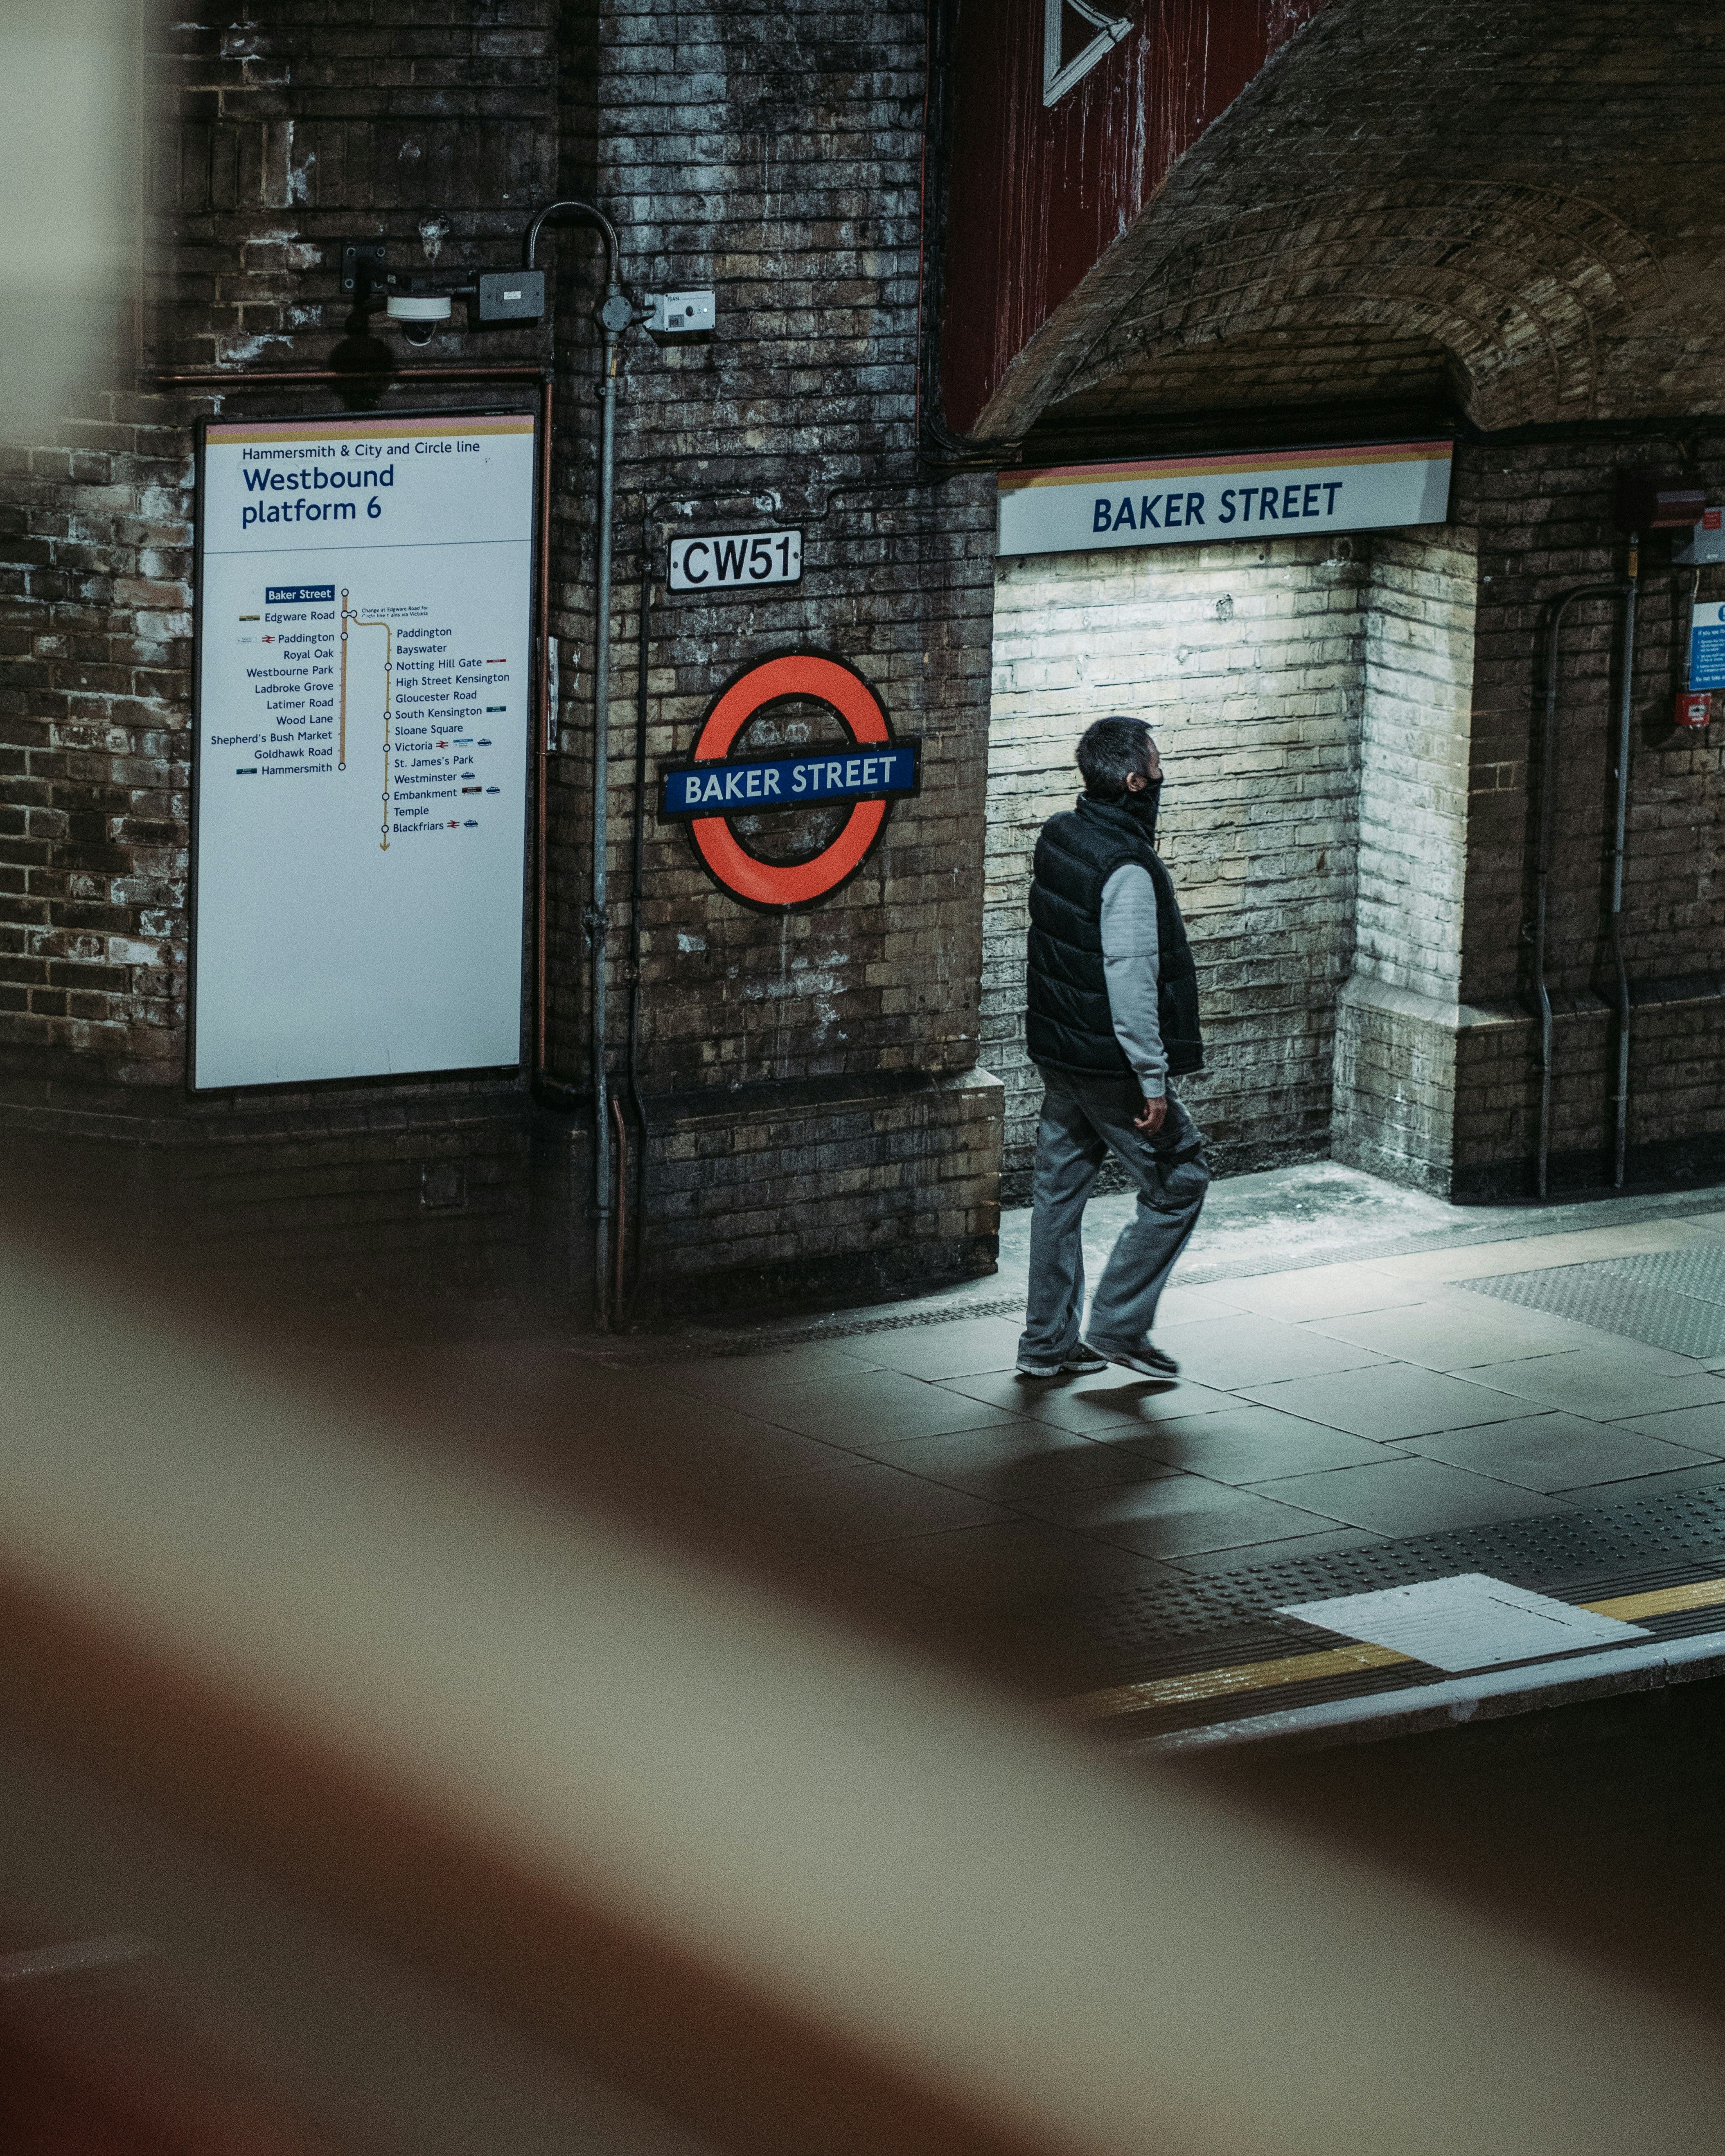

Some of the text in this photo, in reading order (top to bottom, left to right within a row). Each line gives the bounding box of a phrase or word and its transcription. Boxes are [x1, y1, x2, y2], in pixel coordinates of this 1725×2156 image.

[243, 441, 480, 460] Hammersmith & City and Circle line
[243, 464, 393, 491] Westbound
[243, 496, 381, 529] platform 6
[1093, 482, 1342, 532] BAKER STREET
[683, 536, 790, 584] CW51
[269, 590, 331, 600] Baker Street
[265, 611, 334, 624] Edgware Road
[279, 634, 334, 644] Paddington
[397, 629, 451, 638] Paddington
[284, 649, 333, 661] Royal Oak
[397, 645, 446, 656] Bayswater
[397, 659, 482, 671] Notting Hill Gate
[247, 666, 333, 677] Westbourne Park
[397, 674, 509, 688] High Street Kensington
[255, 683, 333, 693] Ladbroke Grove
[396, 691, 476, 703] Gloucester Road
[267, 698, 333, 709] Latimer Road
[396, 708, 482, 719] South Kensington
[277, 715, 333, 725] Wood Lane
[395, 725, 463, 735] Sloane Square
[211, 731, 332, 746] Shepherd's Bush Market
[395, 742, 432, 751] Victoria
[255, 747, 332, 759] Goldhawk Road
[395, 755, 473, 768] St. James's Park
[262, 764, 332, 775] Hammersmith
[395, 774, 456, 784] Westminster
[686, 757, 896, 803] BAKER STREET
[394, 789, 457, 800] Embankment
[394, 807, 428, 817] Temple
[394, 822, 444, 832] Blackfriars
